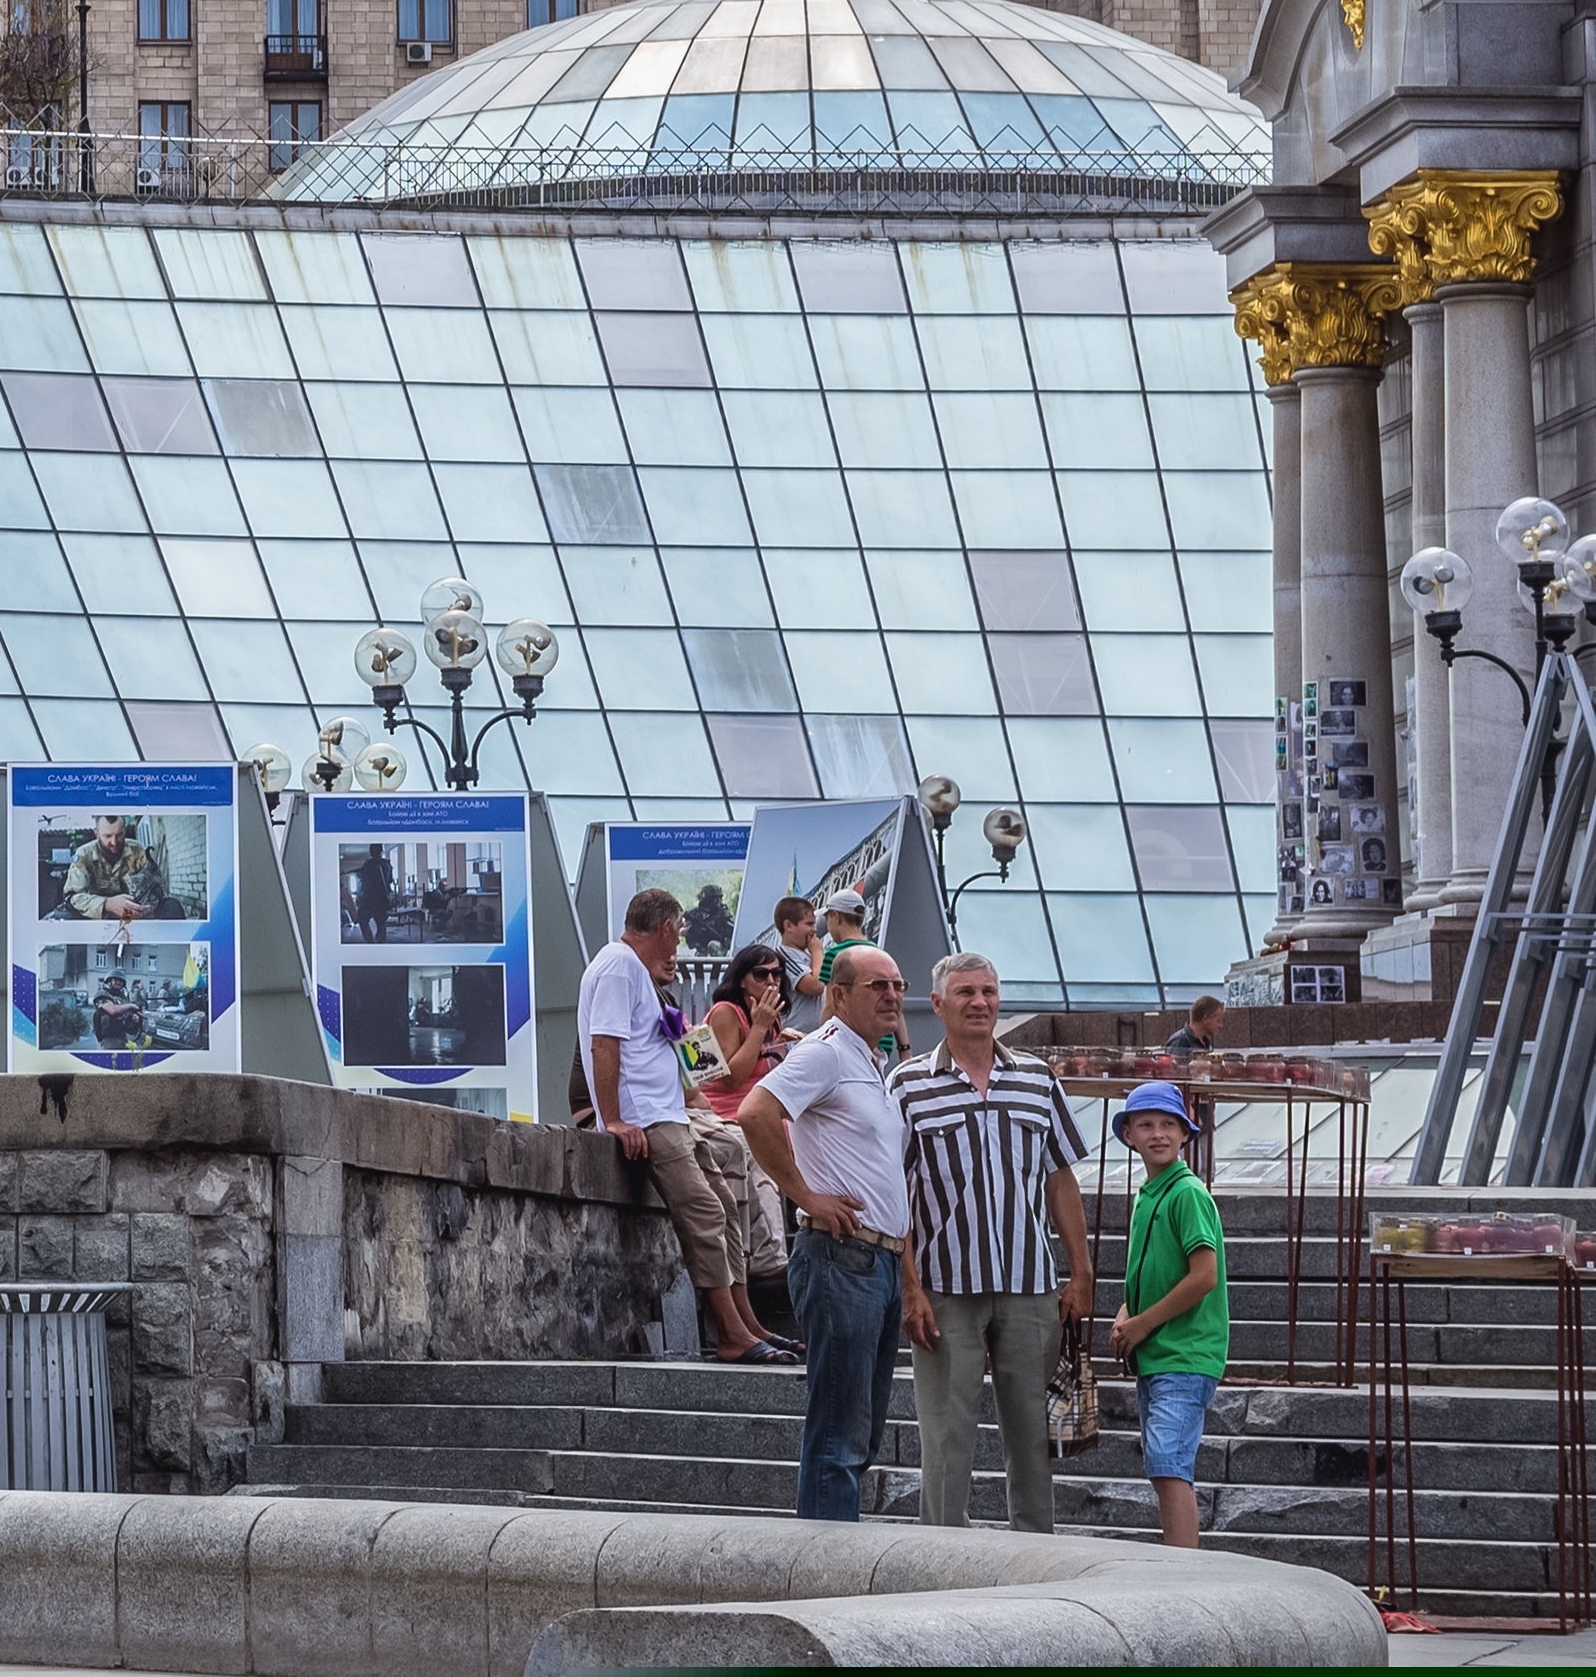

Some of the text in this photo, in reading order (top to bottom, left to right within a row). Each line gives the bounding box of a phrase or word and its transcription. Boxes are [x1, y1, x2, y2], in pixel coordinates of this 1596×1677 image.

[47, 774, 80, 783] СЛАВА
[82, 772, 116, 783] УКРАЇНІ
[123, 774, 160, 783] ГЕРОЯМ
[161, 773, 198, 782] СЛАВА!
[346, 801, 379, 810] СЛАВА
[380, 800, 412, 809] УКРАЇНІ
[419, 801, 454, 809] ГЕРОЯМ
[455, 801, 490, 809] СЛАВА!
[642, 831, 672, 840] СЛАВА
[674, 830, 705, 839] УКРАЇНІ
[711, 831, 745, 839] ГЕРОЯМ
